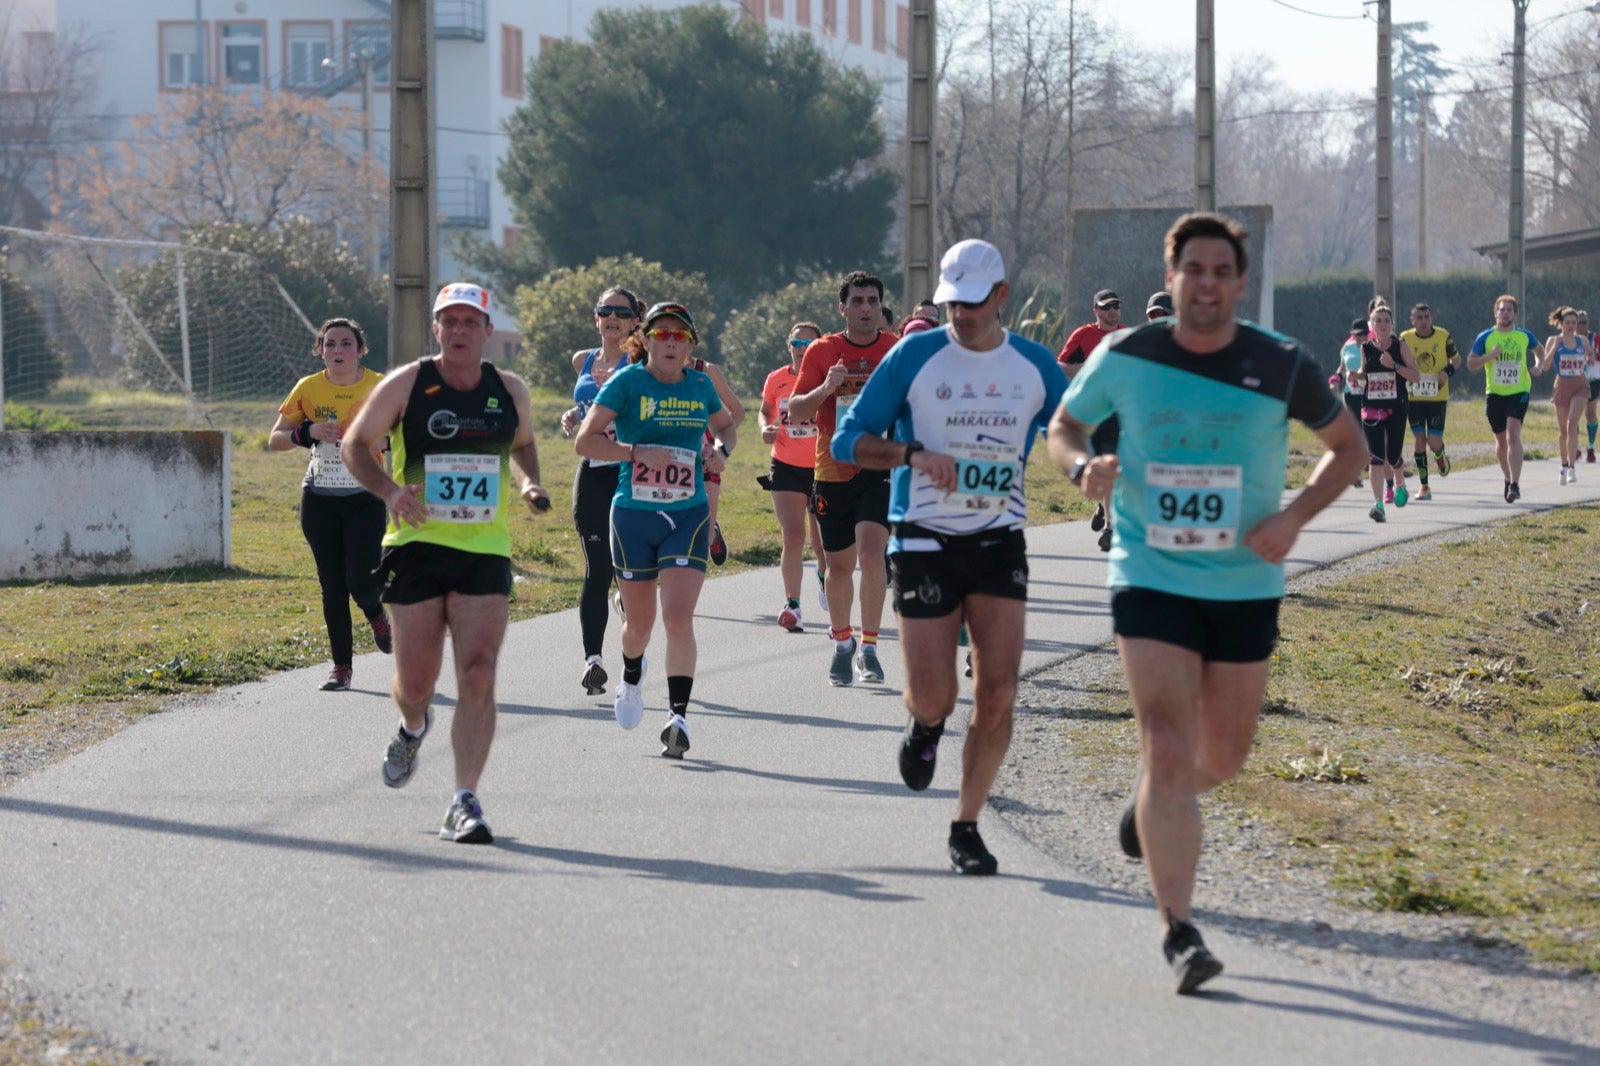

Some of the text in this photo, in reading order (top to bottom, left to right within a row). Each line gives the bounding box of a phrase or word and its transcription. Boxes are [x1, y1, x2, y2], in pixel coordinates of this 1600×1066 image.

[1369, 380, 1395, 391] 2267
[659, 397, 705, 411] olimpo
[945, 416, 1017, 427] MARACENA
[439, 476, 489, 501] 374
[1159, 492, 1224, 523] 949
